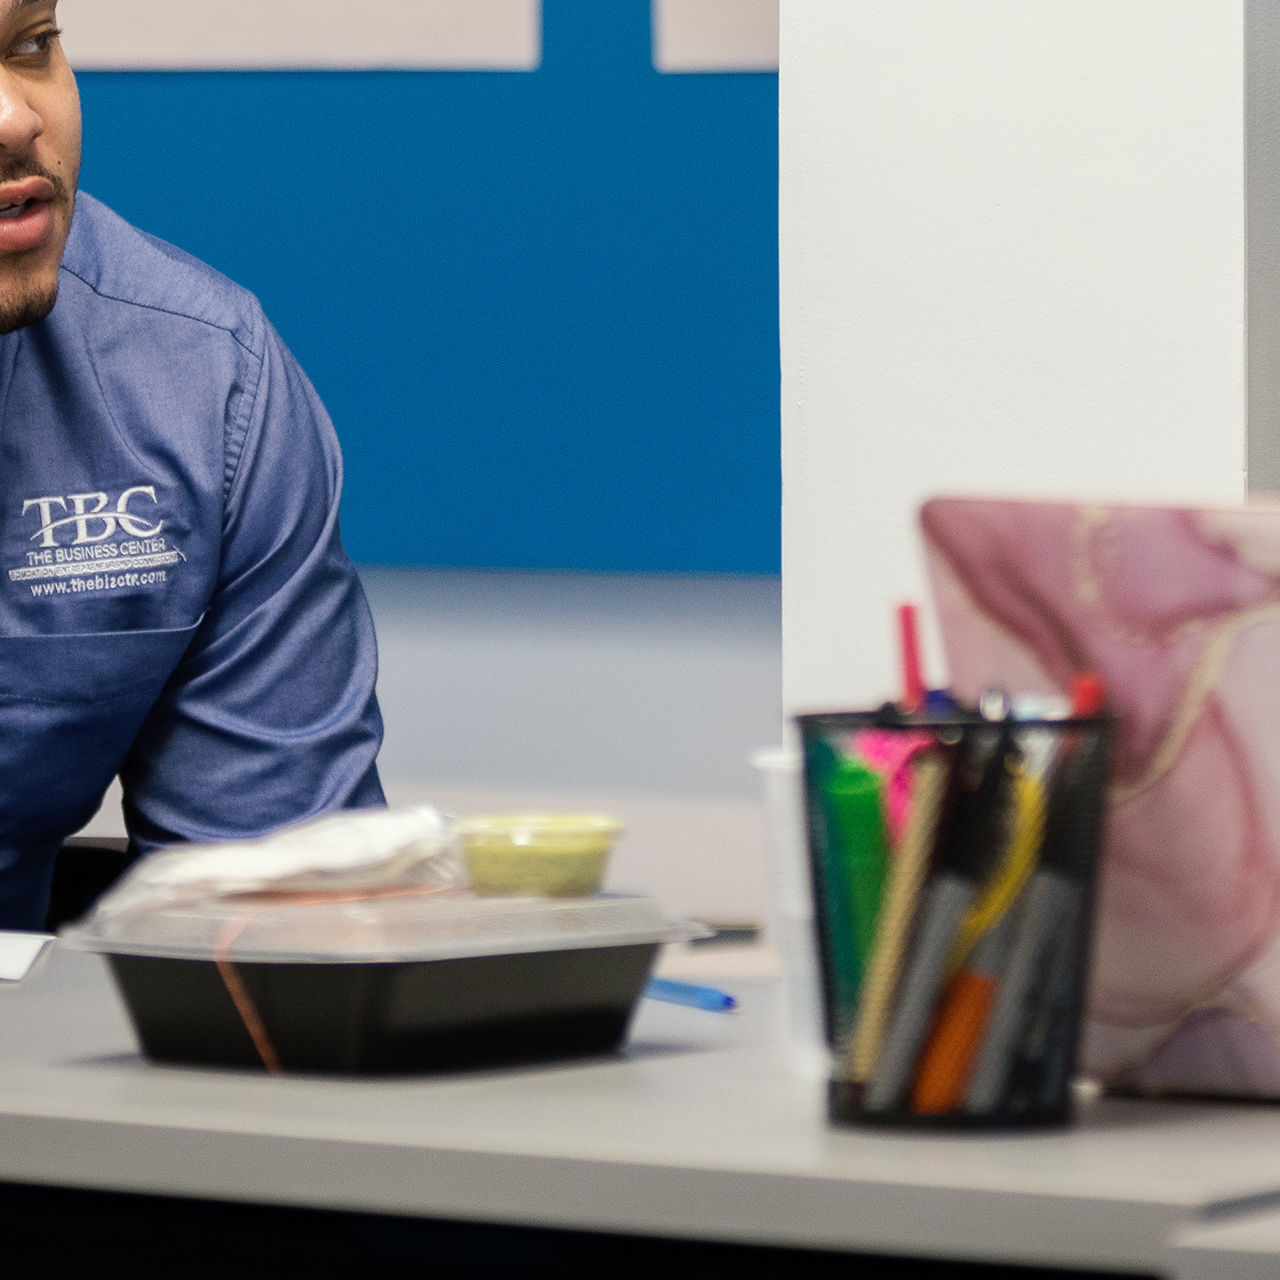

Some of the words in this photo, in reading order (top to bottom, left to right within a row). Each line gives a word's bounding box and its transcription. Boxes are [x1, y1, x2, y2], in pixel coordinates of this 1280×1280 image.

[22, 486, 163, 548] TBC
[26, 550, 53, 566] THE
[55, 543, 118, 563] BUSINESS
[120, 537, 166, 556] CENTER
